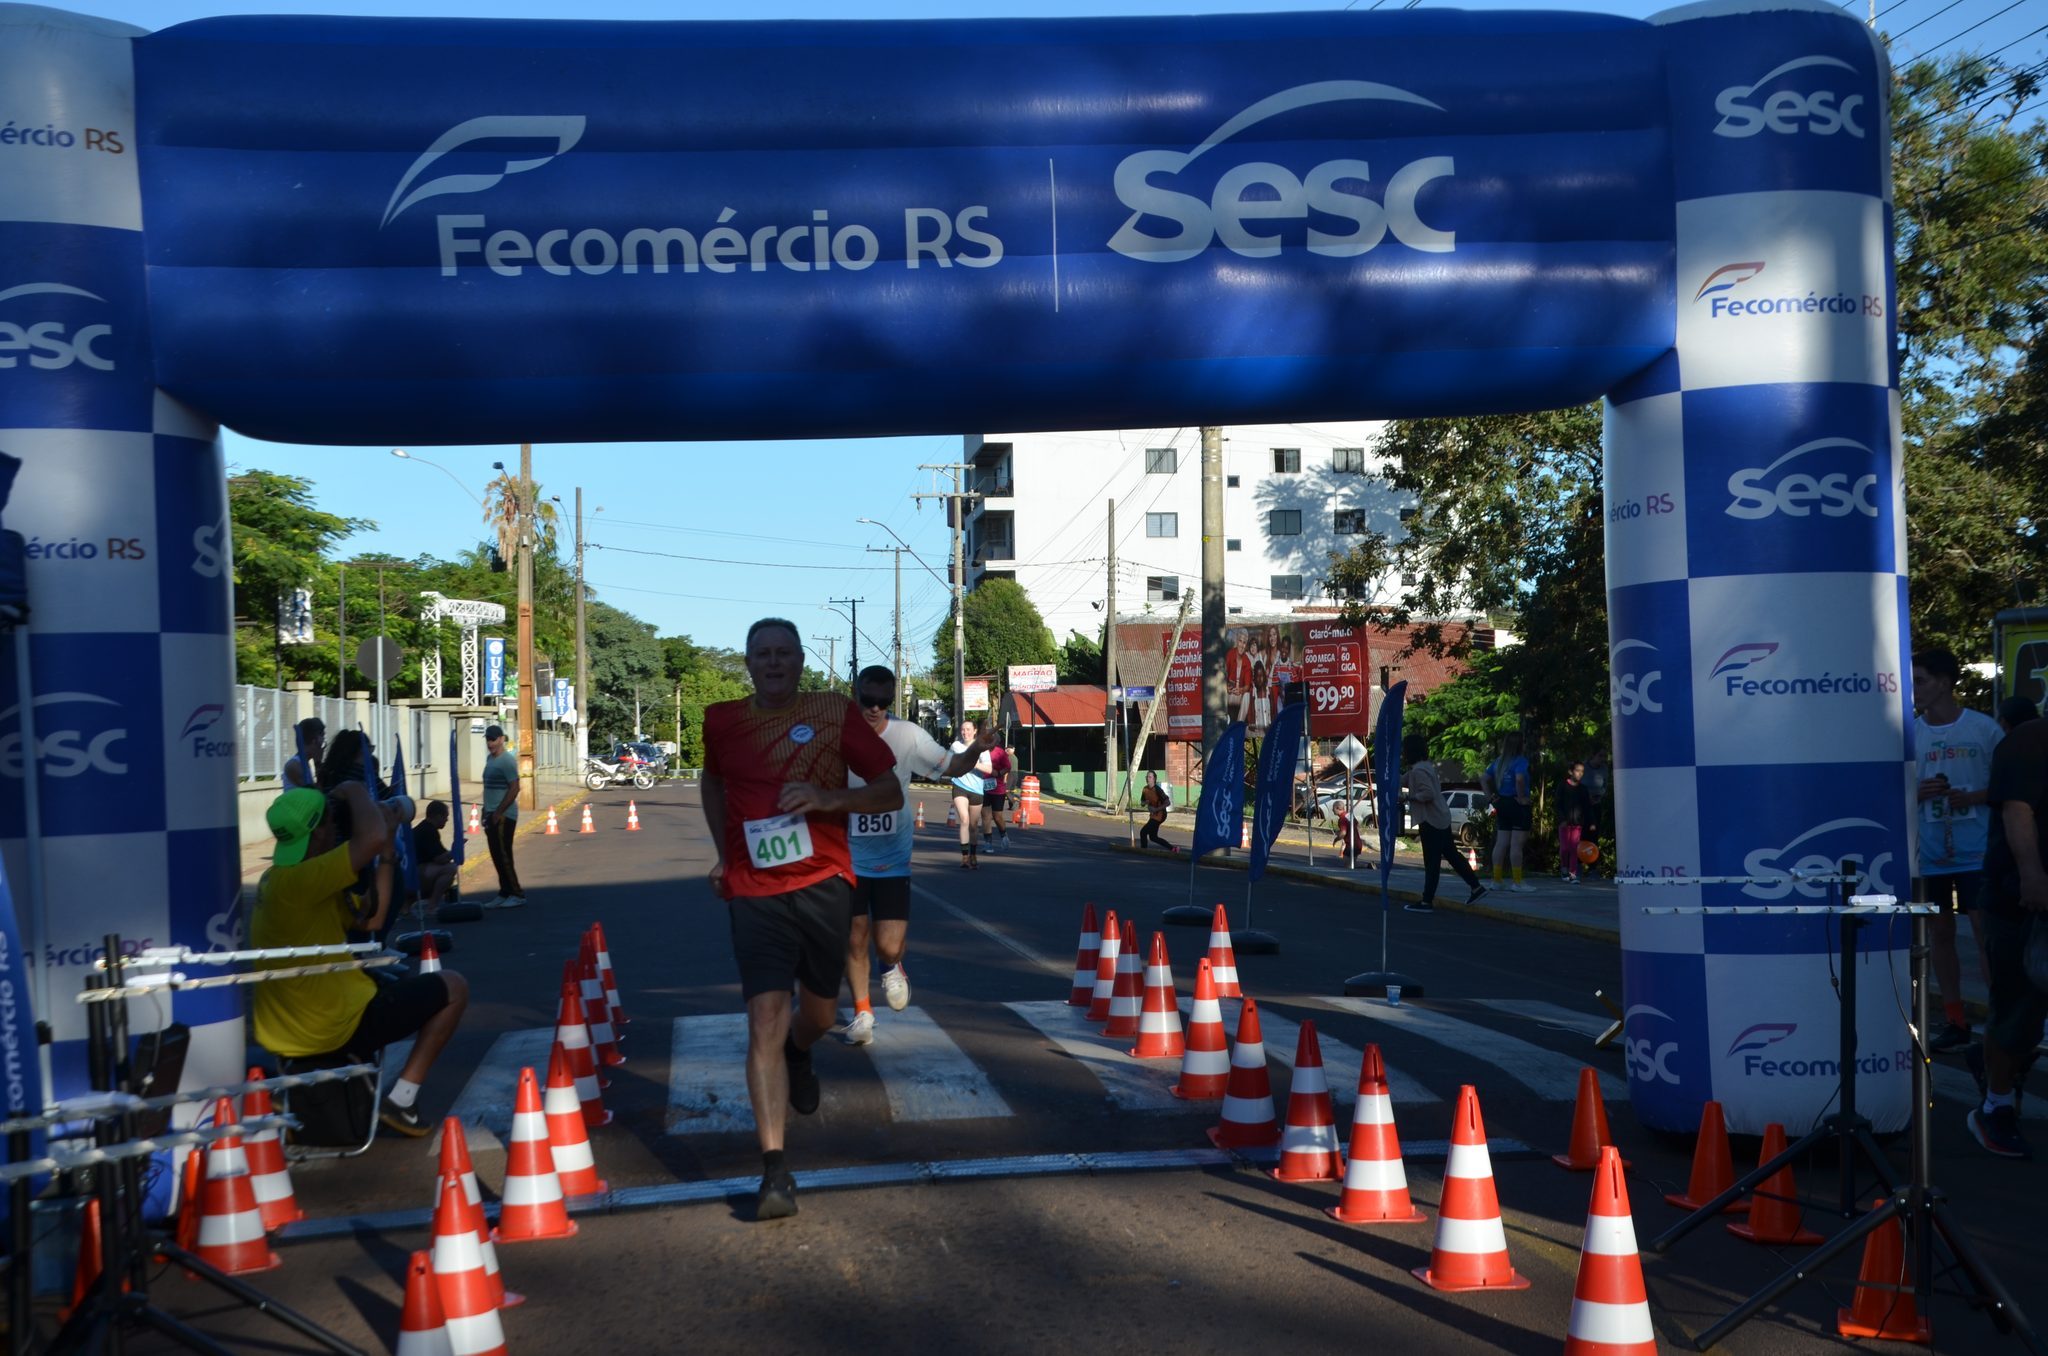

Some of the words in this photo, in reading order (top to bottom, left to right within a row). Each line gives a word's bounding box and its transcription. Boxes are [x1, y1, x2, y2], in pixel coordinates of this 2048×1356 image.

[84, 127, 124, 154] RS
[1106, 150, 1456, 263] Sesc
[437, 206, 880, 277] Fecomércio
[904, 206, 1005, 269] RS
[1712, 291, 1857, 318] Fecomércio
[1861, 295, 1883, 318] RS
[1646, 492, 1675, 516] RS
[106, 538, 146, 560] RS
[1305, 654, 1318, 664] 600
[1318, 653, 1336, 663] MEGA
[1341, 652, 1350, 662] 60
[1341, 662, 1357, 672] GIGA
[1726, 672, 1872, 697] Fecomércio
[1877, 673, 1898, 694] RS
[858, 813, 893, 833] 850
[756, 830, 802, 863] 401
[1744, 1052, 1890, 1077] Fecomrcio
